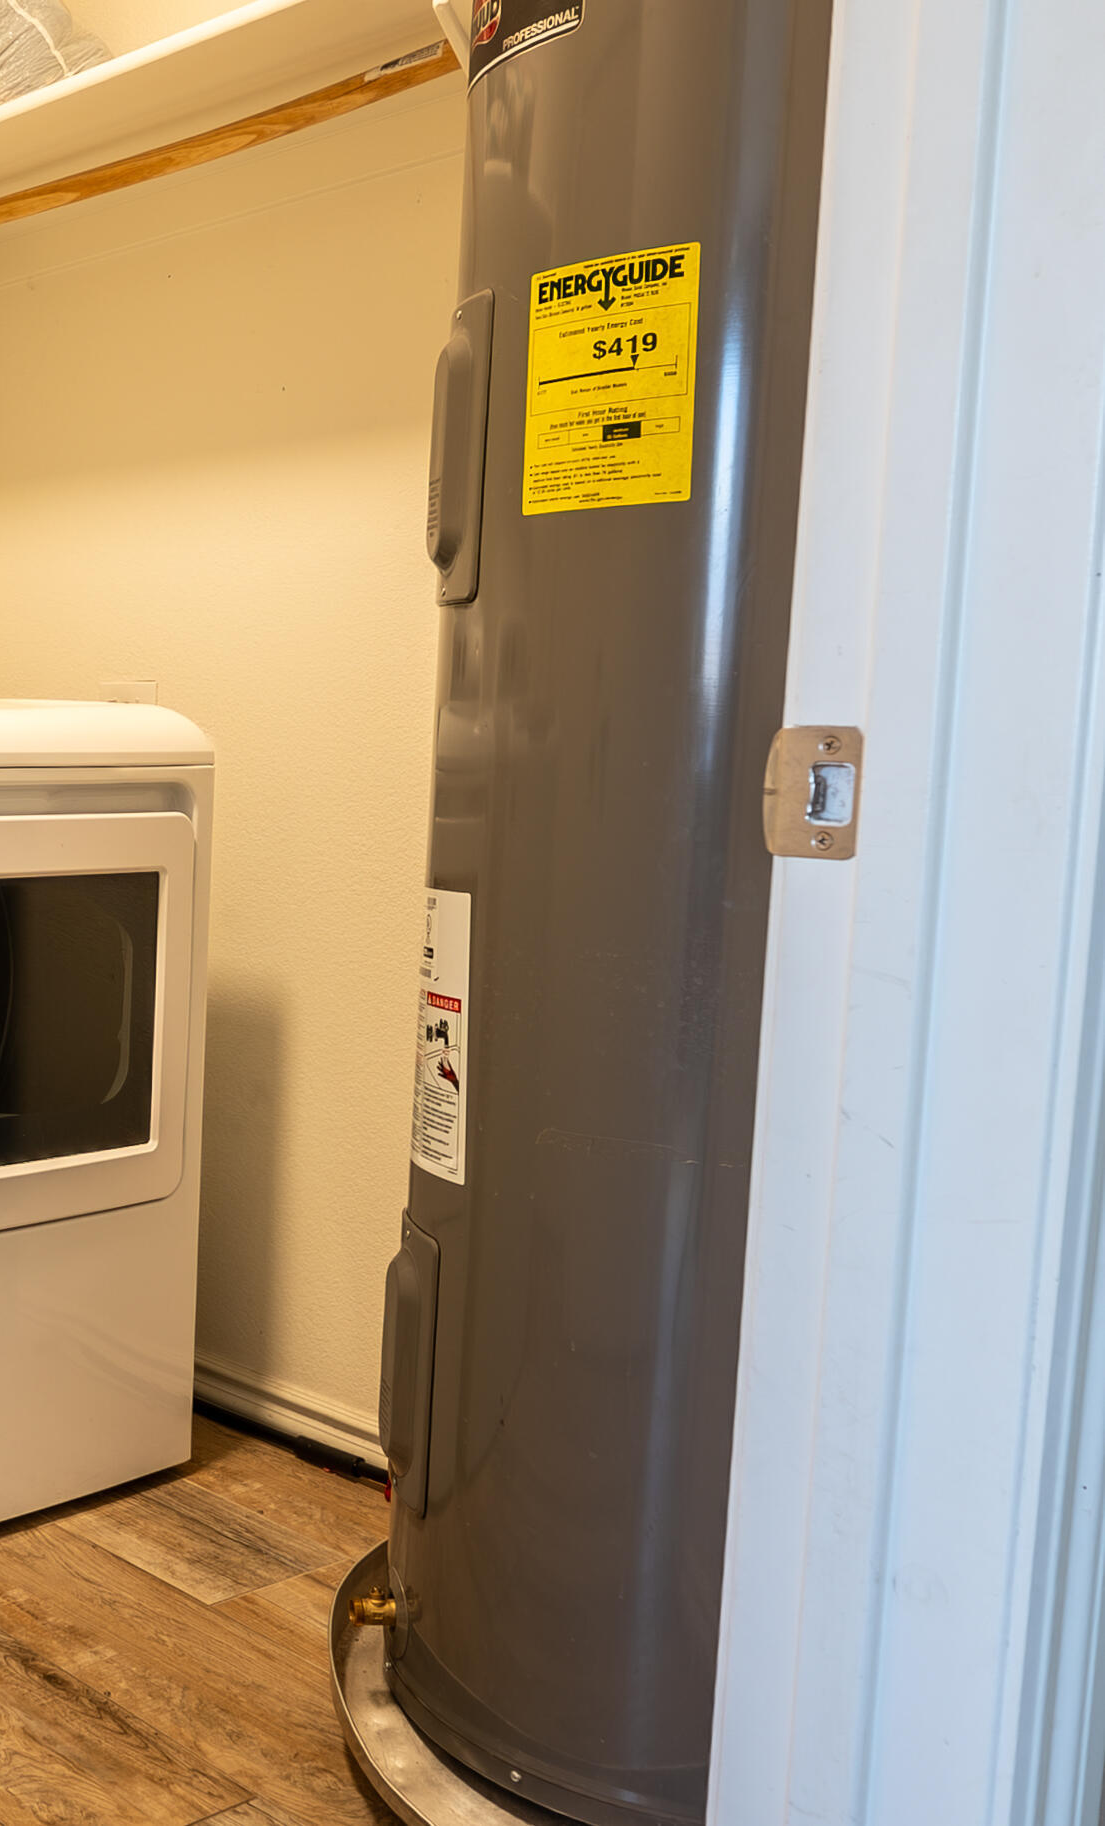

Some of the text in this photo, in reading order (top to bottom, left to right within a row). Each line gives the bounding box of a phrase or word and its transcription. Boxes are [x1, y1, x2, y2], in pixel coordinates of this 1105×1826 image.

[502, 6, 580, 51] PROFESSIONAL
[538, 254, 685, 305] ENERGYGUIDE
[592, 332, 658, 360] $419
